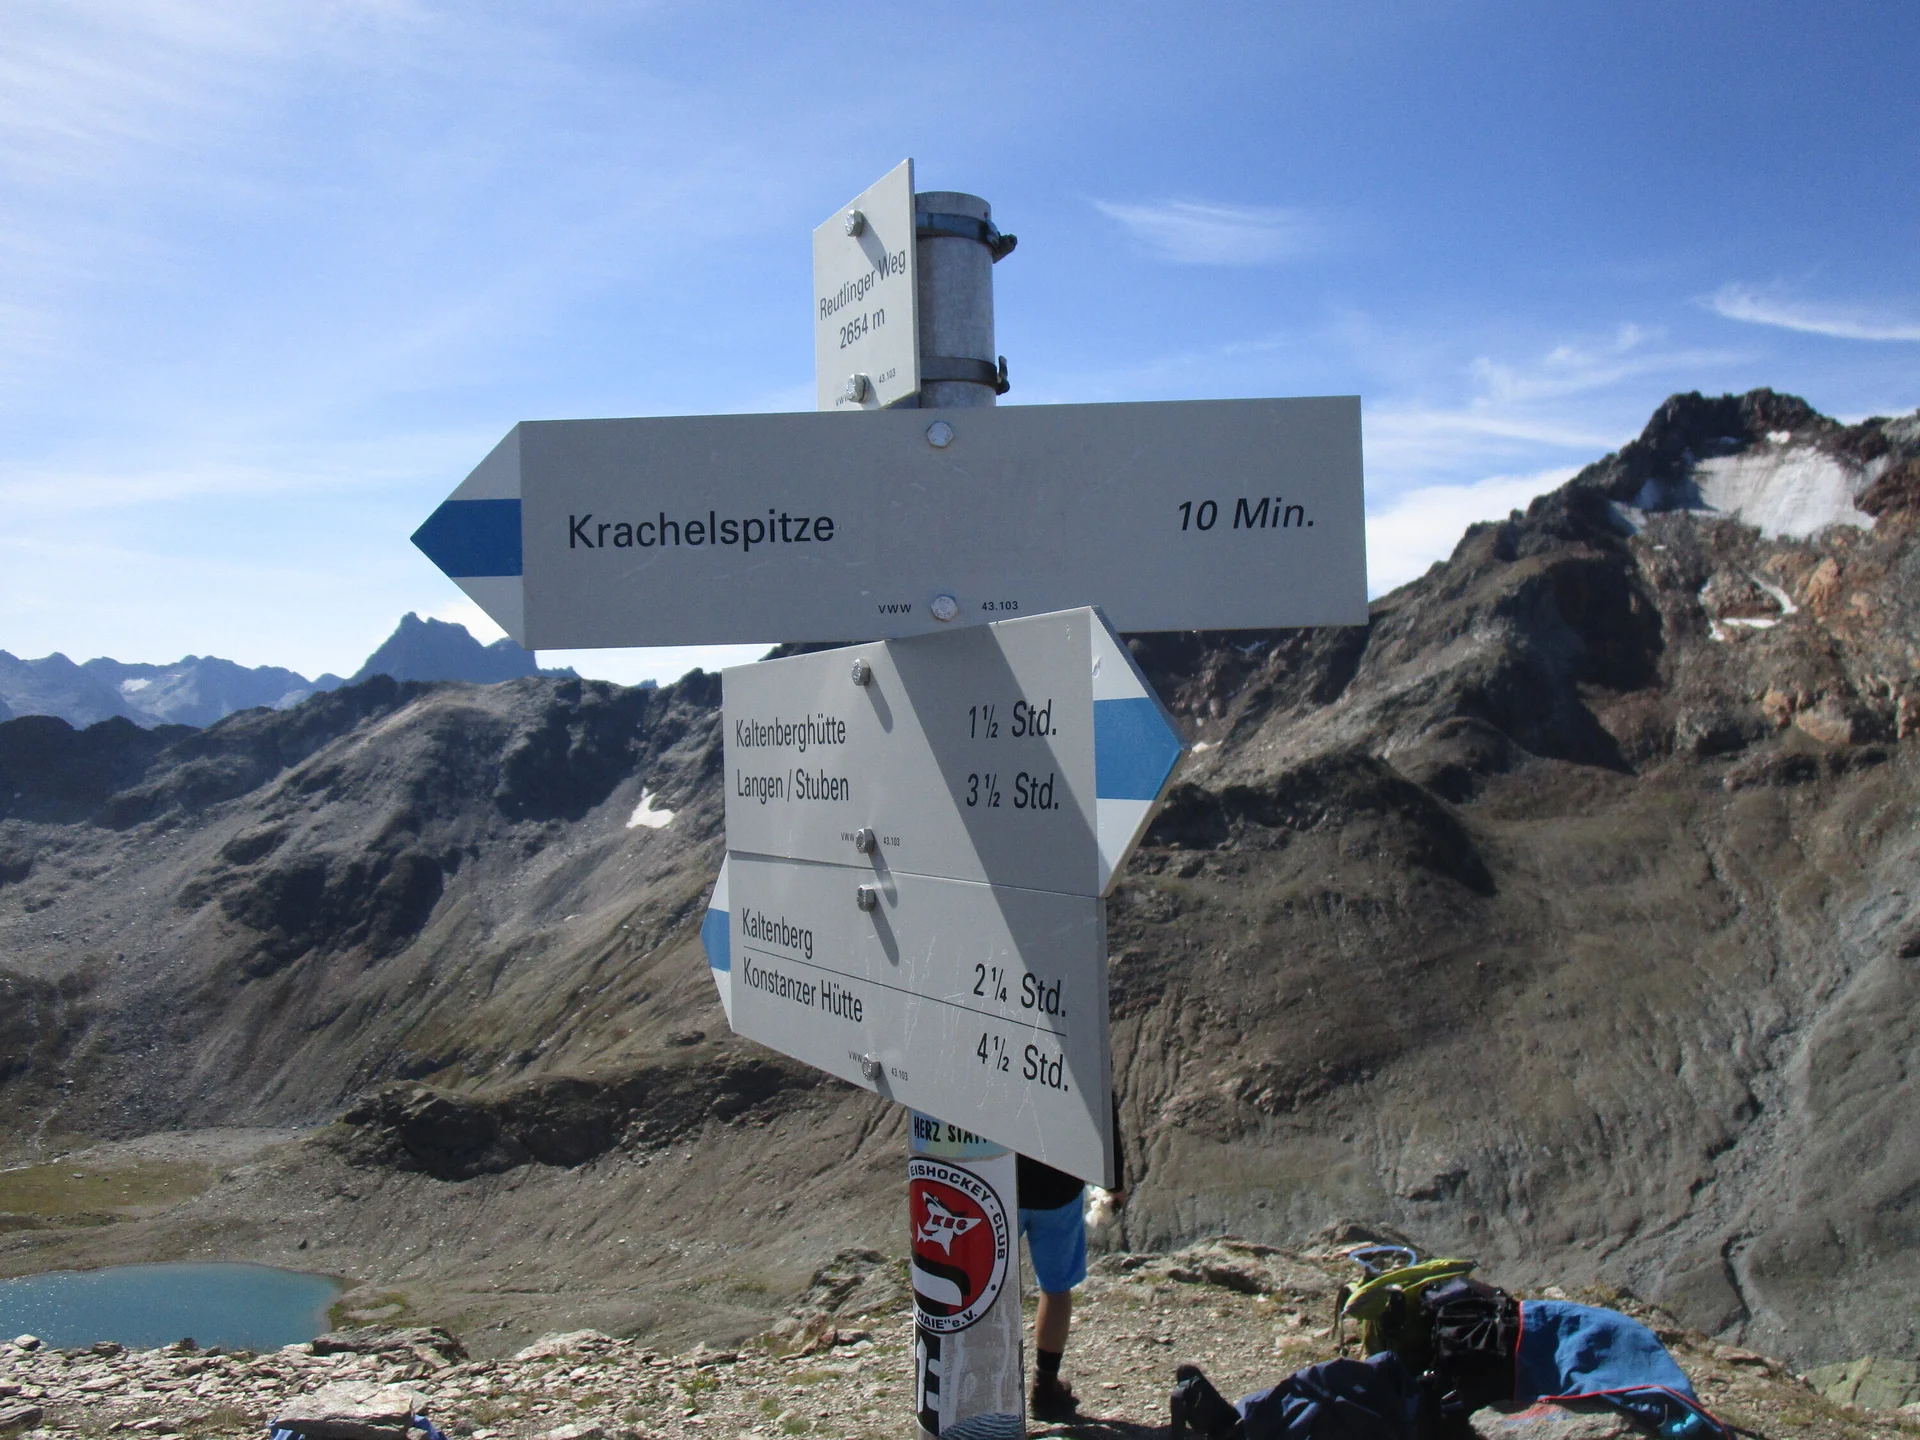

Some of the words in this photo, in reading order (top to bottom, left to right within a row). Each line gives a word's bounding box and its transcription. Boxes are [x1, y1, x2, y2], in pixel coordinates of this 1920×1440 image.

[820, 269, 876, 321] Reutlinger
[878, 249, 906, 281] Weg
[840, 313, 869, 350] 2654
[872, 308, 885, 330] m
[878, 368, 896, 384] 43.103
[569, 508, 835, 552] Krachelspitze
[1178, 500, 1218, 531] 10
[1233, 497, 1314, 529] Min.
[878, 604, 912, 614] VWW
[981, 601, 1019, 611] 43.103
[736, 713, 846, 753] Kaltenberghütte
[1012, 699, 1057, 737] Std.
[737, 769, 783, 805] Langen
[796, 768, 849, 801] Stuben
[1014, 772, 1059, 810] Std.
[883, 836, 901, 847] 43.103
[742, 907, 813, 960] Kaltenberg
[1020, 972, 1066, 1017] Std.
[743, 956, 816, 1007] Konstanzer
[821, 979, 863, 1023] Hütte
[1023, 1044, 1068, 1092] Std.
[891, 1067, 909, 1081] 43.103
[914, 1116, 941, 1142] HERZ
[910, 1165, 991, 1202] EISHOCKEY
[992, 1212, 1006, 1259] CLUB
